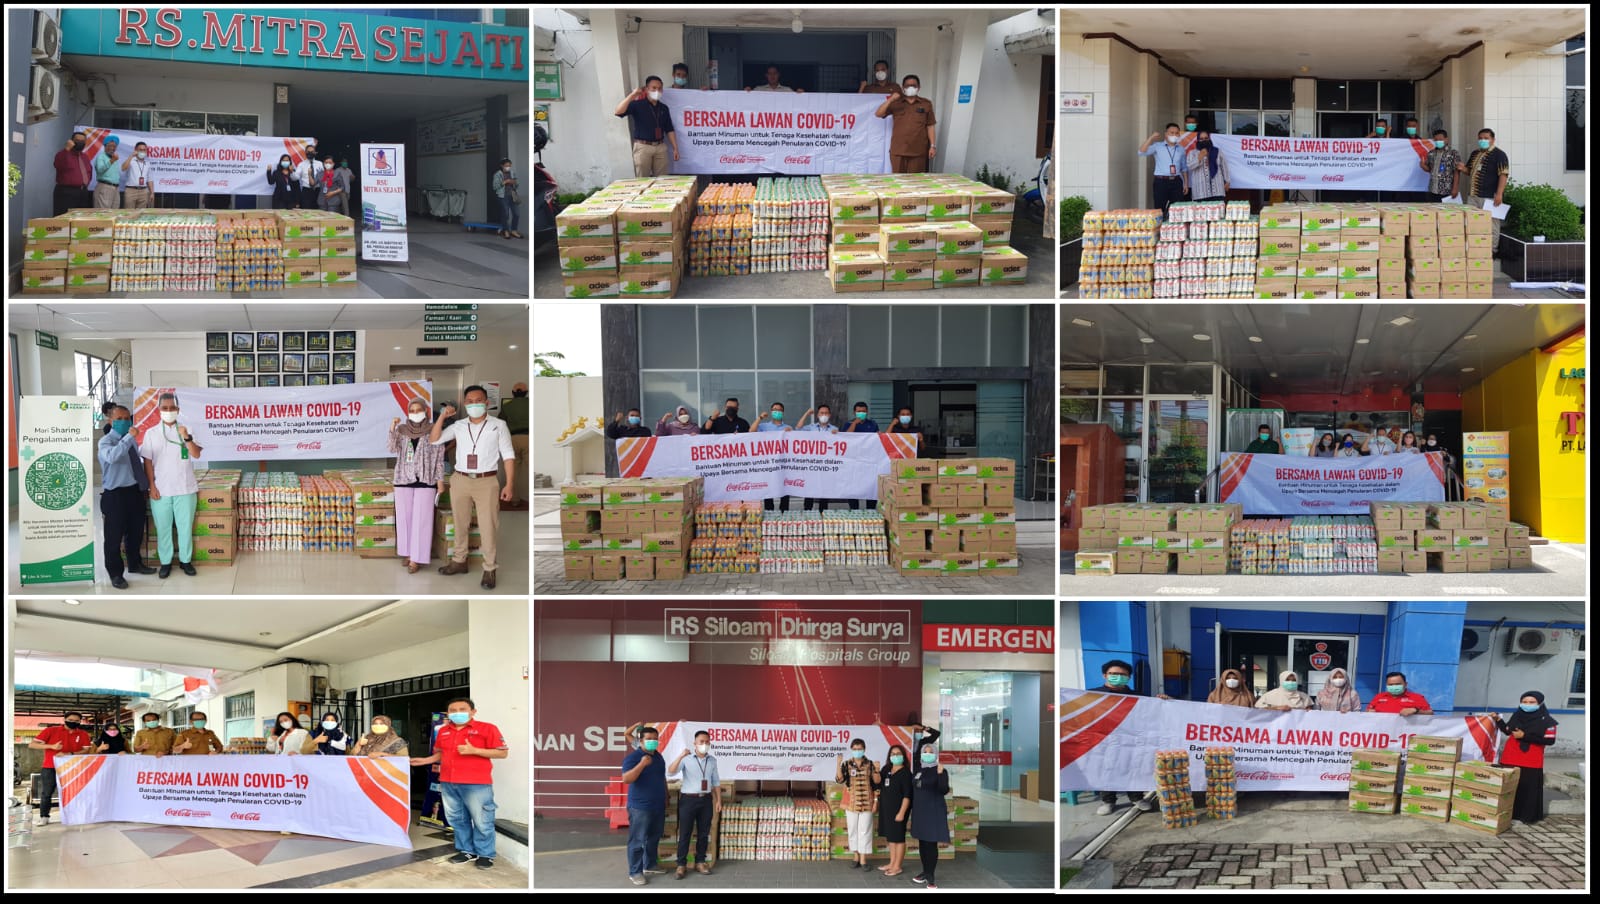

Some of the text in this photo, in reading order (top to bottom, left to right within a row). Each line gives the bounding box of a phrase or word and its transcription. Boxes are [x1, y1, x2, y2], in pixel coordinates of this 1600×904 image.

[374, 26, 523, 70] SEJATI
[684, 111, 856, 129] BERSAMA LAWAN COVID-19
[184, 147, 215, 160] LAWAN
[219, 149, 261, 161] COVID-19
[1241, 138, 1380, 153] BERSAMA LAWAN COVID-19
[205, 402, 361, 419] BERSAMA LAWAN COVID-19
[691, 440, 847, 461] BERSAMA LAWAN COVID-19
[1276, 468, 1403, 480] BERSAMA LAWAN COVID-19
[670, 617, 904, 639] RS Siloam Dhirga Surya
[868, 648, 910, 664] Group
[708, 728, 850, 744] BERSAMA LAWAN COVID-19
[1185, 724, 1270, 744] BERSAMA
[1277, 729, 1332, 746] LAWAN
[1270, 756, 1315, 764] Mencegah
[137, 771, 308, 789] BERSAMA LAWAN COVID-19
